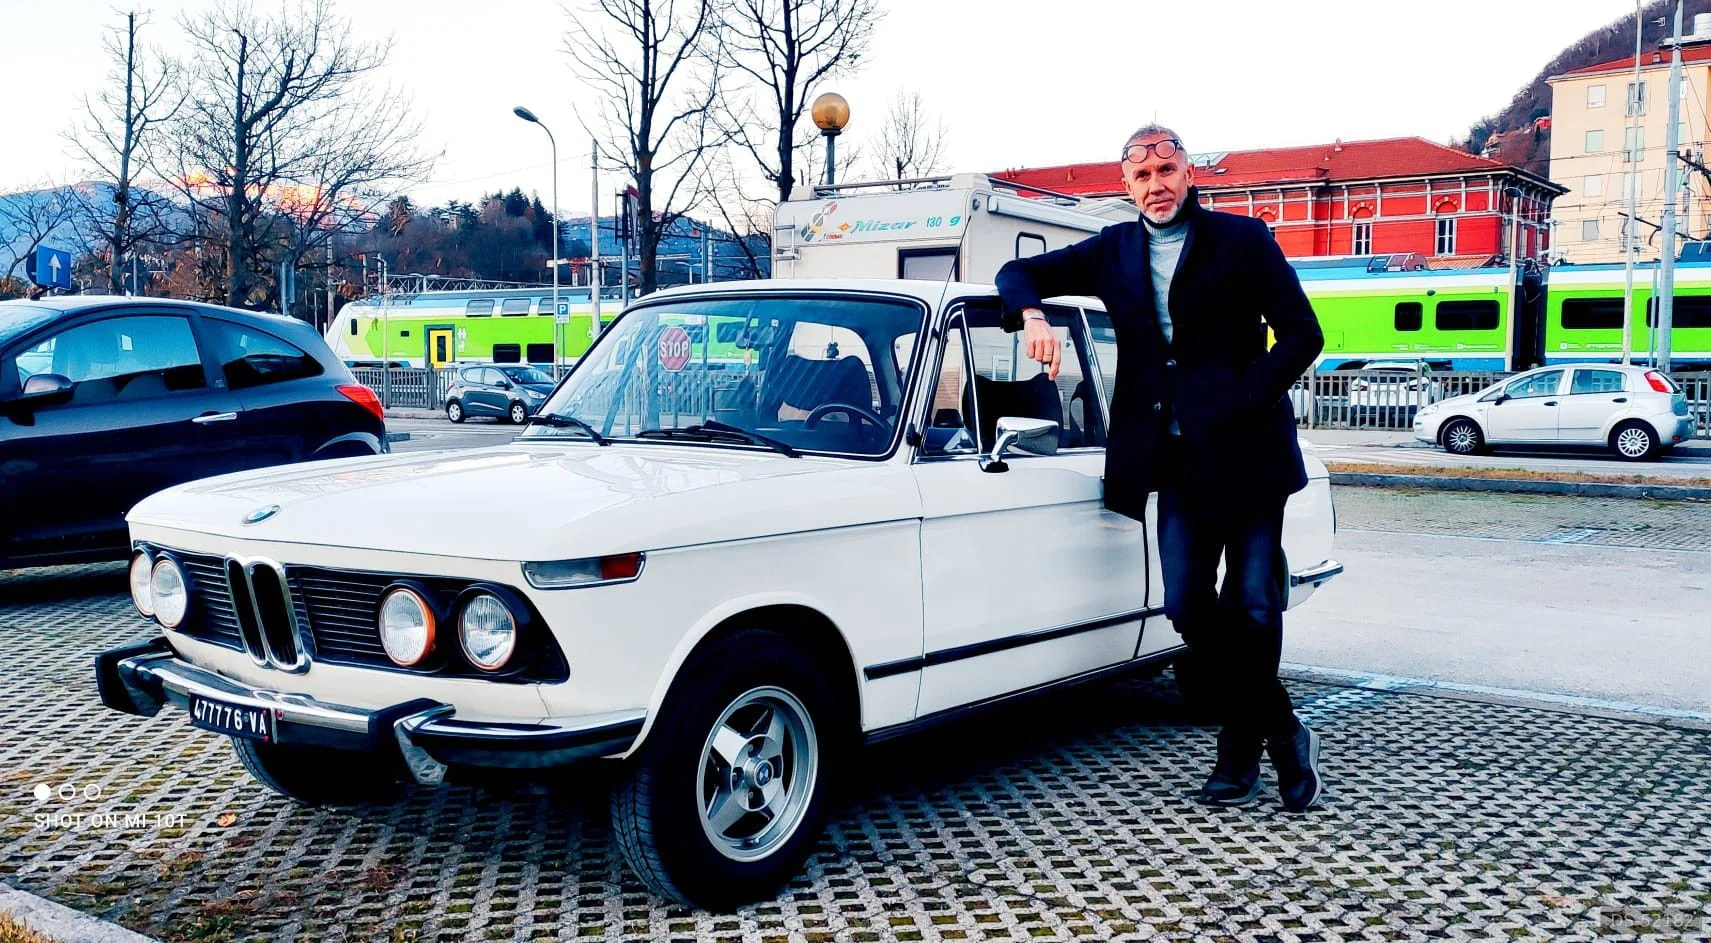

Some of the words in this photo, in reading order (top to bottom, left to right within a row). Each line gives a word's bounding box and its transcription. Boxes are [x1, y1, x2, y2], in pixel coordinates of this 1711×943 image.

[850, 220, 918, 234] Mizar
[926, 215, 943, 228] 130
[660, 340, 689, 358] STOP
[194, 698, 243, 731] 477776
[249, 711, 267, 735] VA
